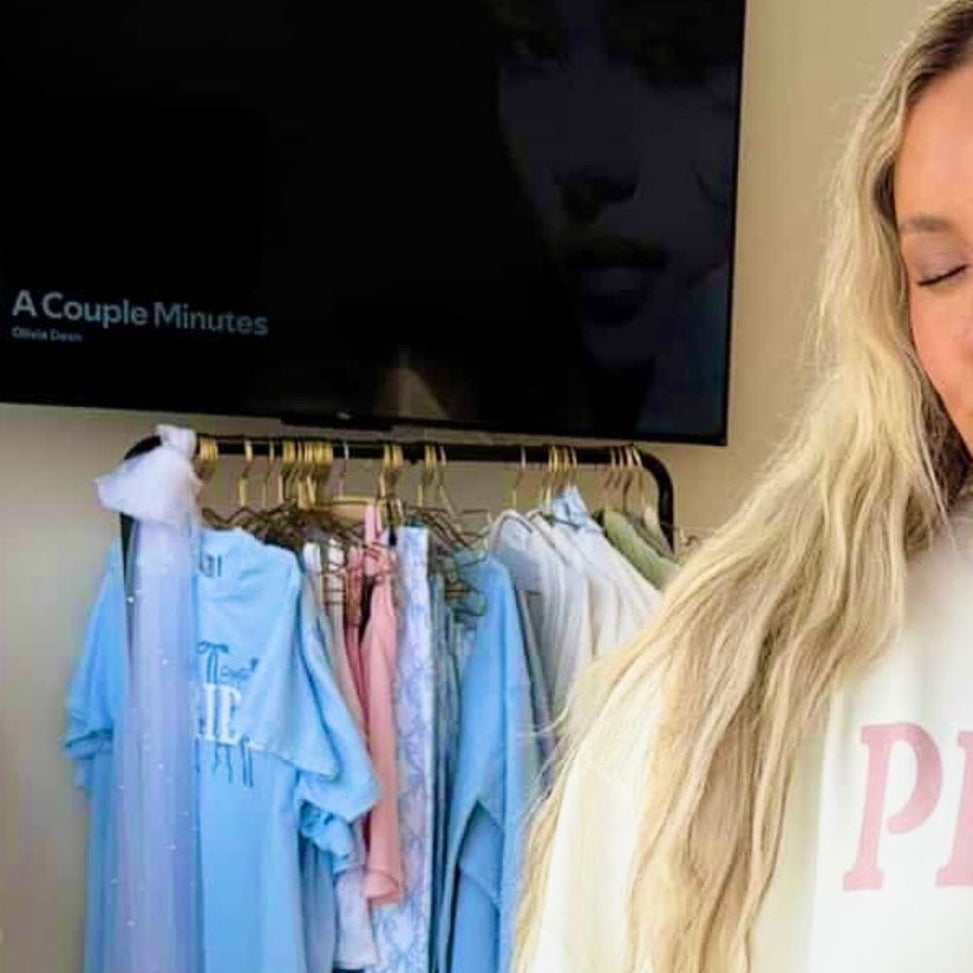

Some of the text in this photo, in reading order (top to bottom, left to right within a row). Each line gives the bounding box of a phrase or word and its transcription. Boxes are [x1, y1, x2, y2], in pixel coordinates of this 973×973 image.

[12, 289, 269, 336] A Couple Minutes
